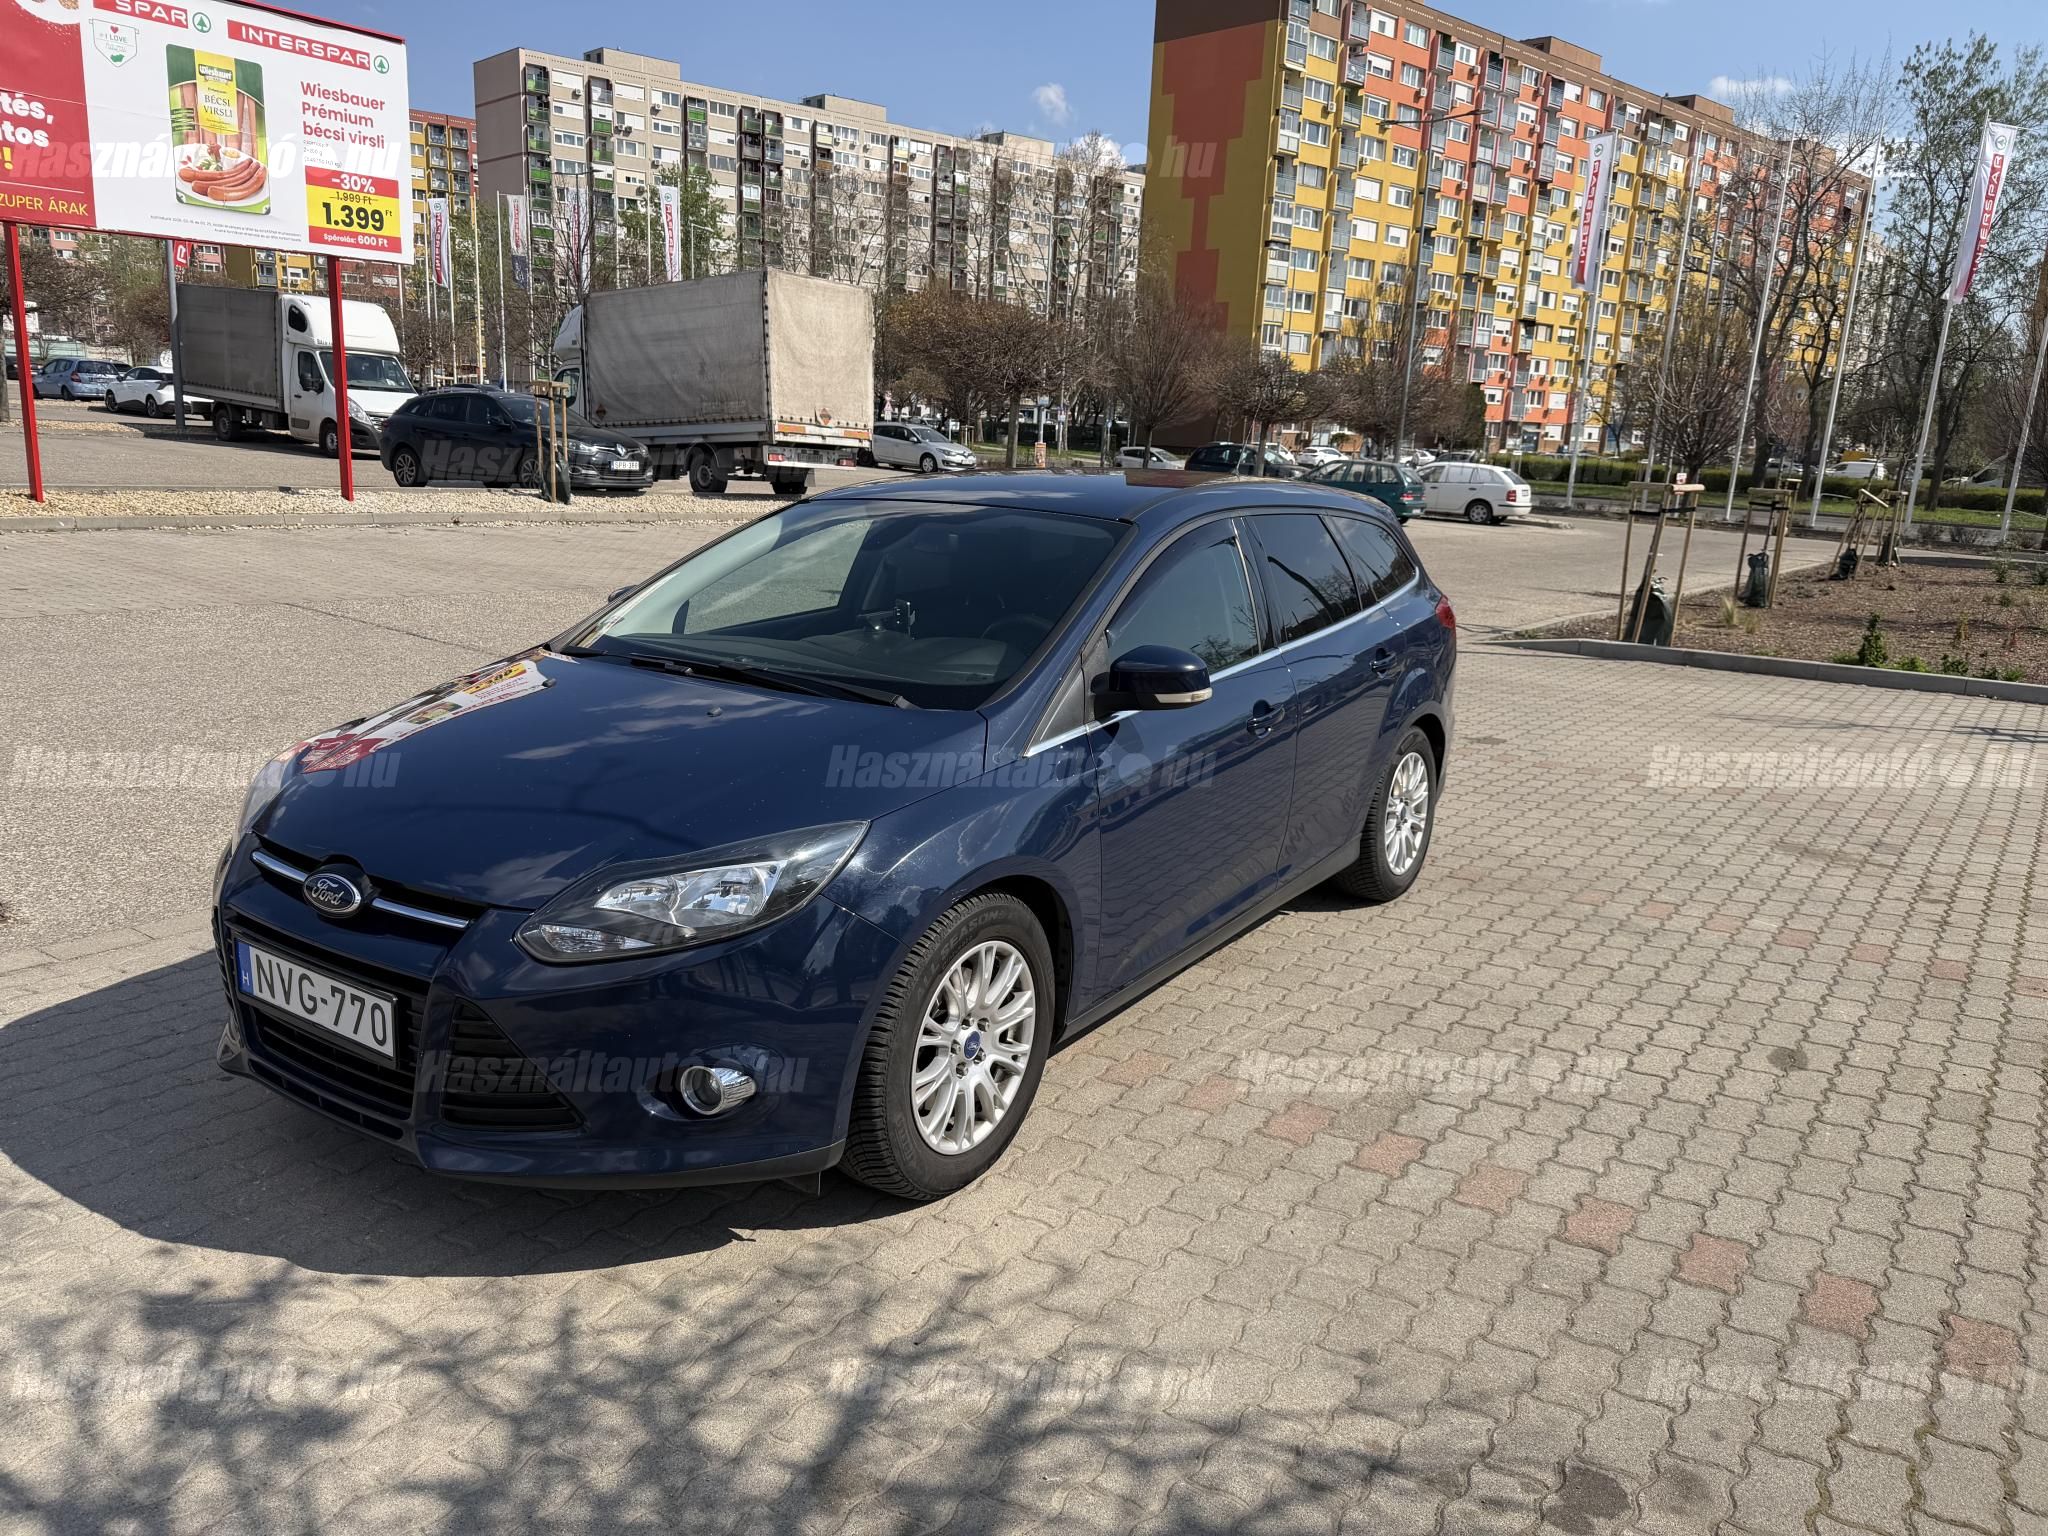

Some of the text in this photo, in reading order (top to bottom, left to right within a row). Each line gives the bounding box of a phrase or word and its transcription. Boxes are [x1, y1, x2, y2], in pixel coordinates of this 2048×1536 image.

[115, 0, 187, 26] SPAR
[241, 25, 370, 68] INTERSPAR
[0, 92, 54, 125] tés,
[204, 94, 231, 107] BÉCSI
[300, 80, 385, 111] Wiesbauer
[203, 105, 233, 118] VIRSLI
[302, 101, 374, 128] Prémium
[0, 120, 49, 148] tos
[303, 120, 385, 149] bécsi virsli
[331, 173, 376, 194] -30%
[48, 196, 89, 217] ÁRAK
[335, 191, 372, 205] 1.999 Ft
[322, 201, 384, 232] 1.399
[385, 209, 393, 217] Ft
[1972, 154, 2003, 272] INTERSPAR
[357, 235, 377, 246] 600
[378, 238, 389, 248] Ft
[311, 878, 345, 905] Ford
[255, 953, 387, 1047] NVG-770
